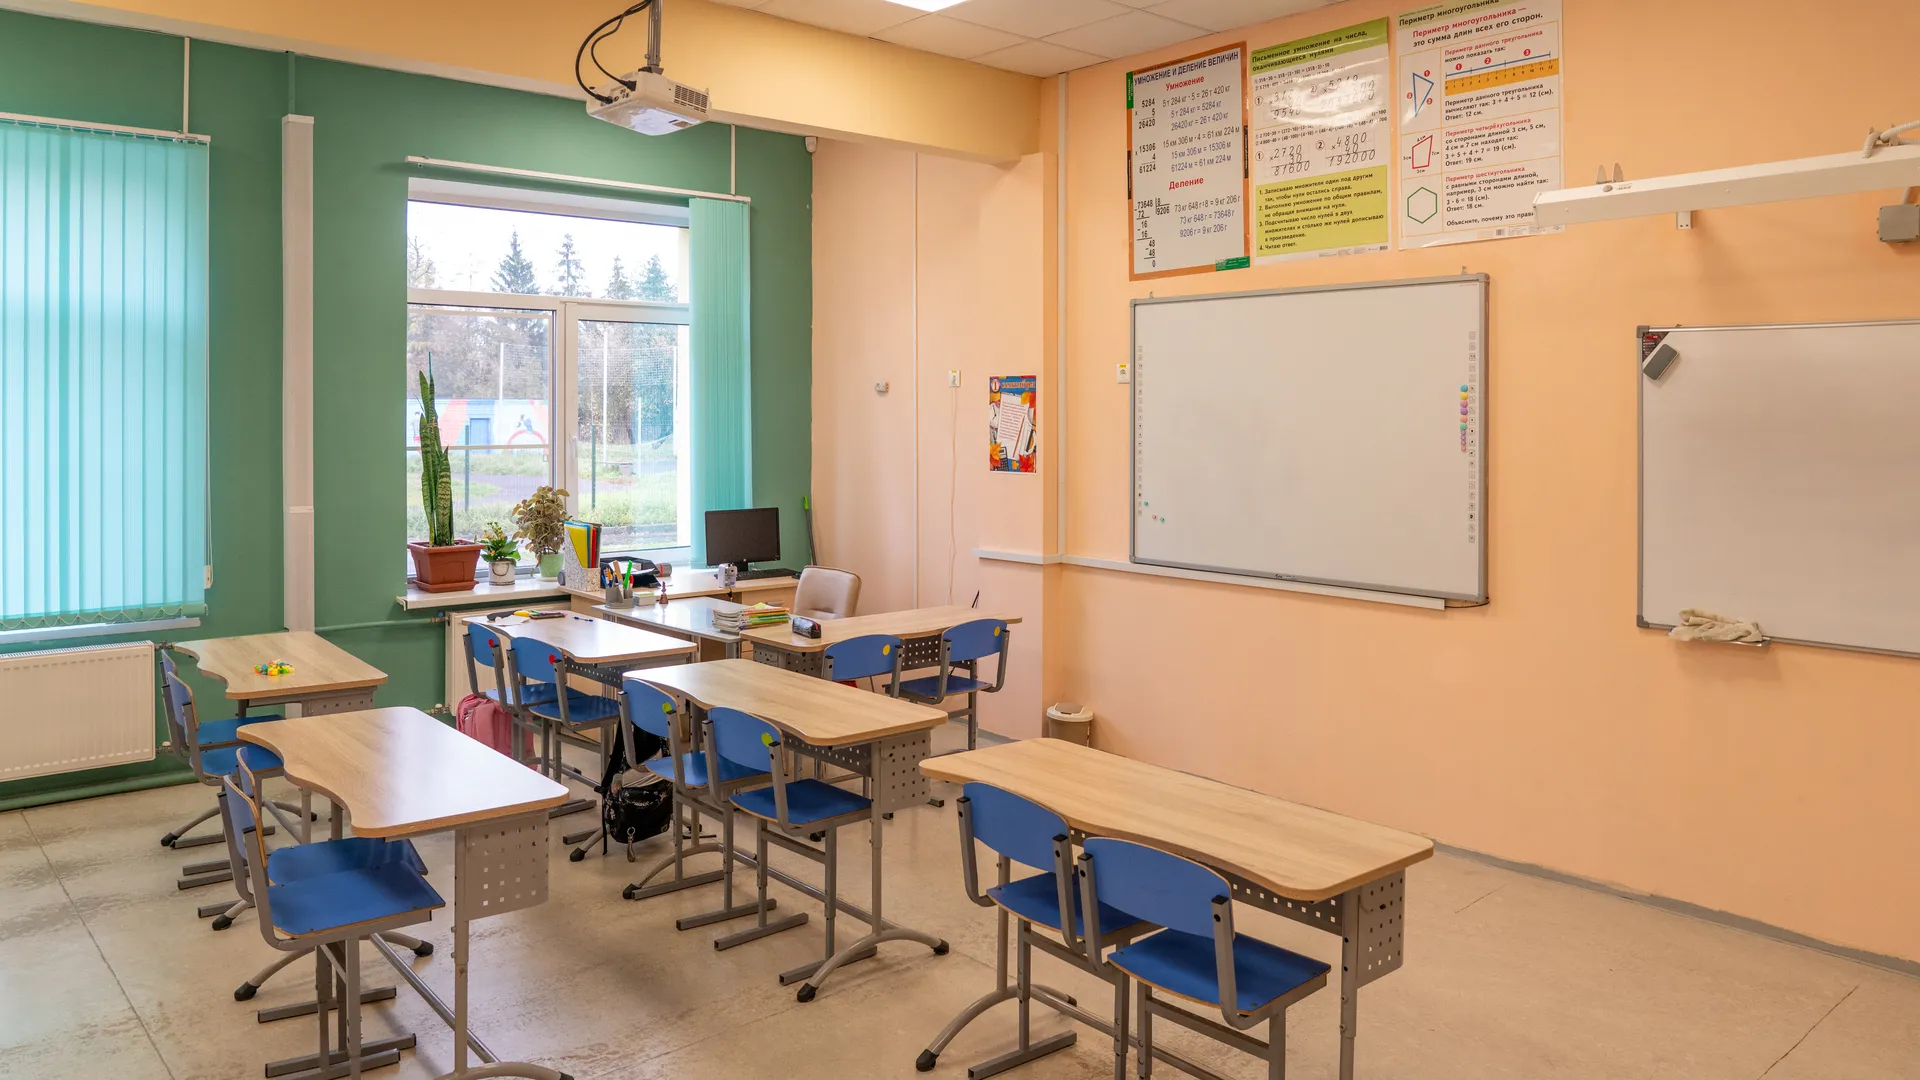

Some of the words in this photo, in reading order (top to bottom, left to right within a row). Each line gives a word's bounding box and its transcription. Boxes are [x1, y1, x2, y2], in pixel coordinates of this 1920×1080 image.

[1400, 14, 1434, 26] Периметр
[1413, 25, 1449, 38] Периметр
[1452, 9, 1516, 28] многоугольника
[1428, 34, 1451, 44] сумма
[1454, 29, 1472, 39] длин
[1512, 13, 1543, 24] сторон.
[1445, 46, 1473, 55] Периметр
[1475, 40, 1499, 50] данного
[1502, 31, 1543, 44] треугольника
[1252, 50, 1290, 63] Письменное
[1294, 40, 1330, 54] умножение
[1466, 50, 1492, 58] показать
[1253, 54, 1306, 71] оканчивающиеся
[1309, 48, 1334, 58] нулями
[1134, 69, 1170, 85] УМНОЖЕНИЕ
[1178, 60, 1206, 76] ДЕЛЕНИЕ
[1208, 52, 1238, 66] ВЕЛИЧИН
[1166, 77, 1204, 91] Умножение
[1445, 98, 1474, 106] Периметр
[1475, 92, 1500, 101] данного
[1502, 84, 1543, 96] треугольника
[1142, 98, 1155, 108] 5284
[1446, 104, 1477, 114] вычисляют
[1139, 119, 1155, 129] 26420
[1446, 129, 1474, 137] Периметр
[1476, 119, 1531, 131] четырёхугольника
[1454, 134, 1486, 142] сторонами
[1488, 128, 1510, 138] длиной
[1140, 143, 1156, 153] 15306
[1139, 164, 1156, 173] 61224
[1476, 167, 1525, 178] шестиугольника
[1169, 178, 1204, 190] Деление
